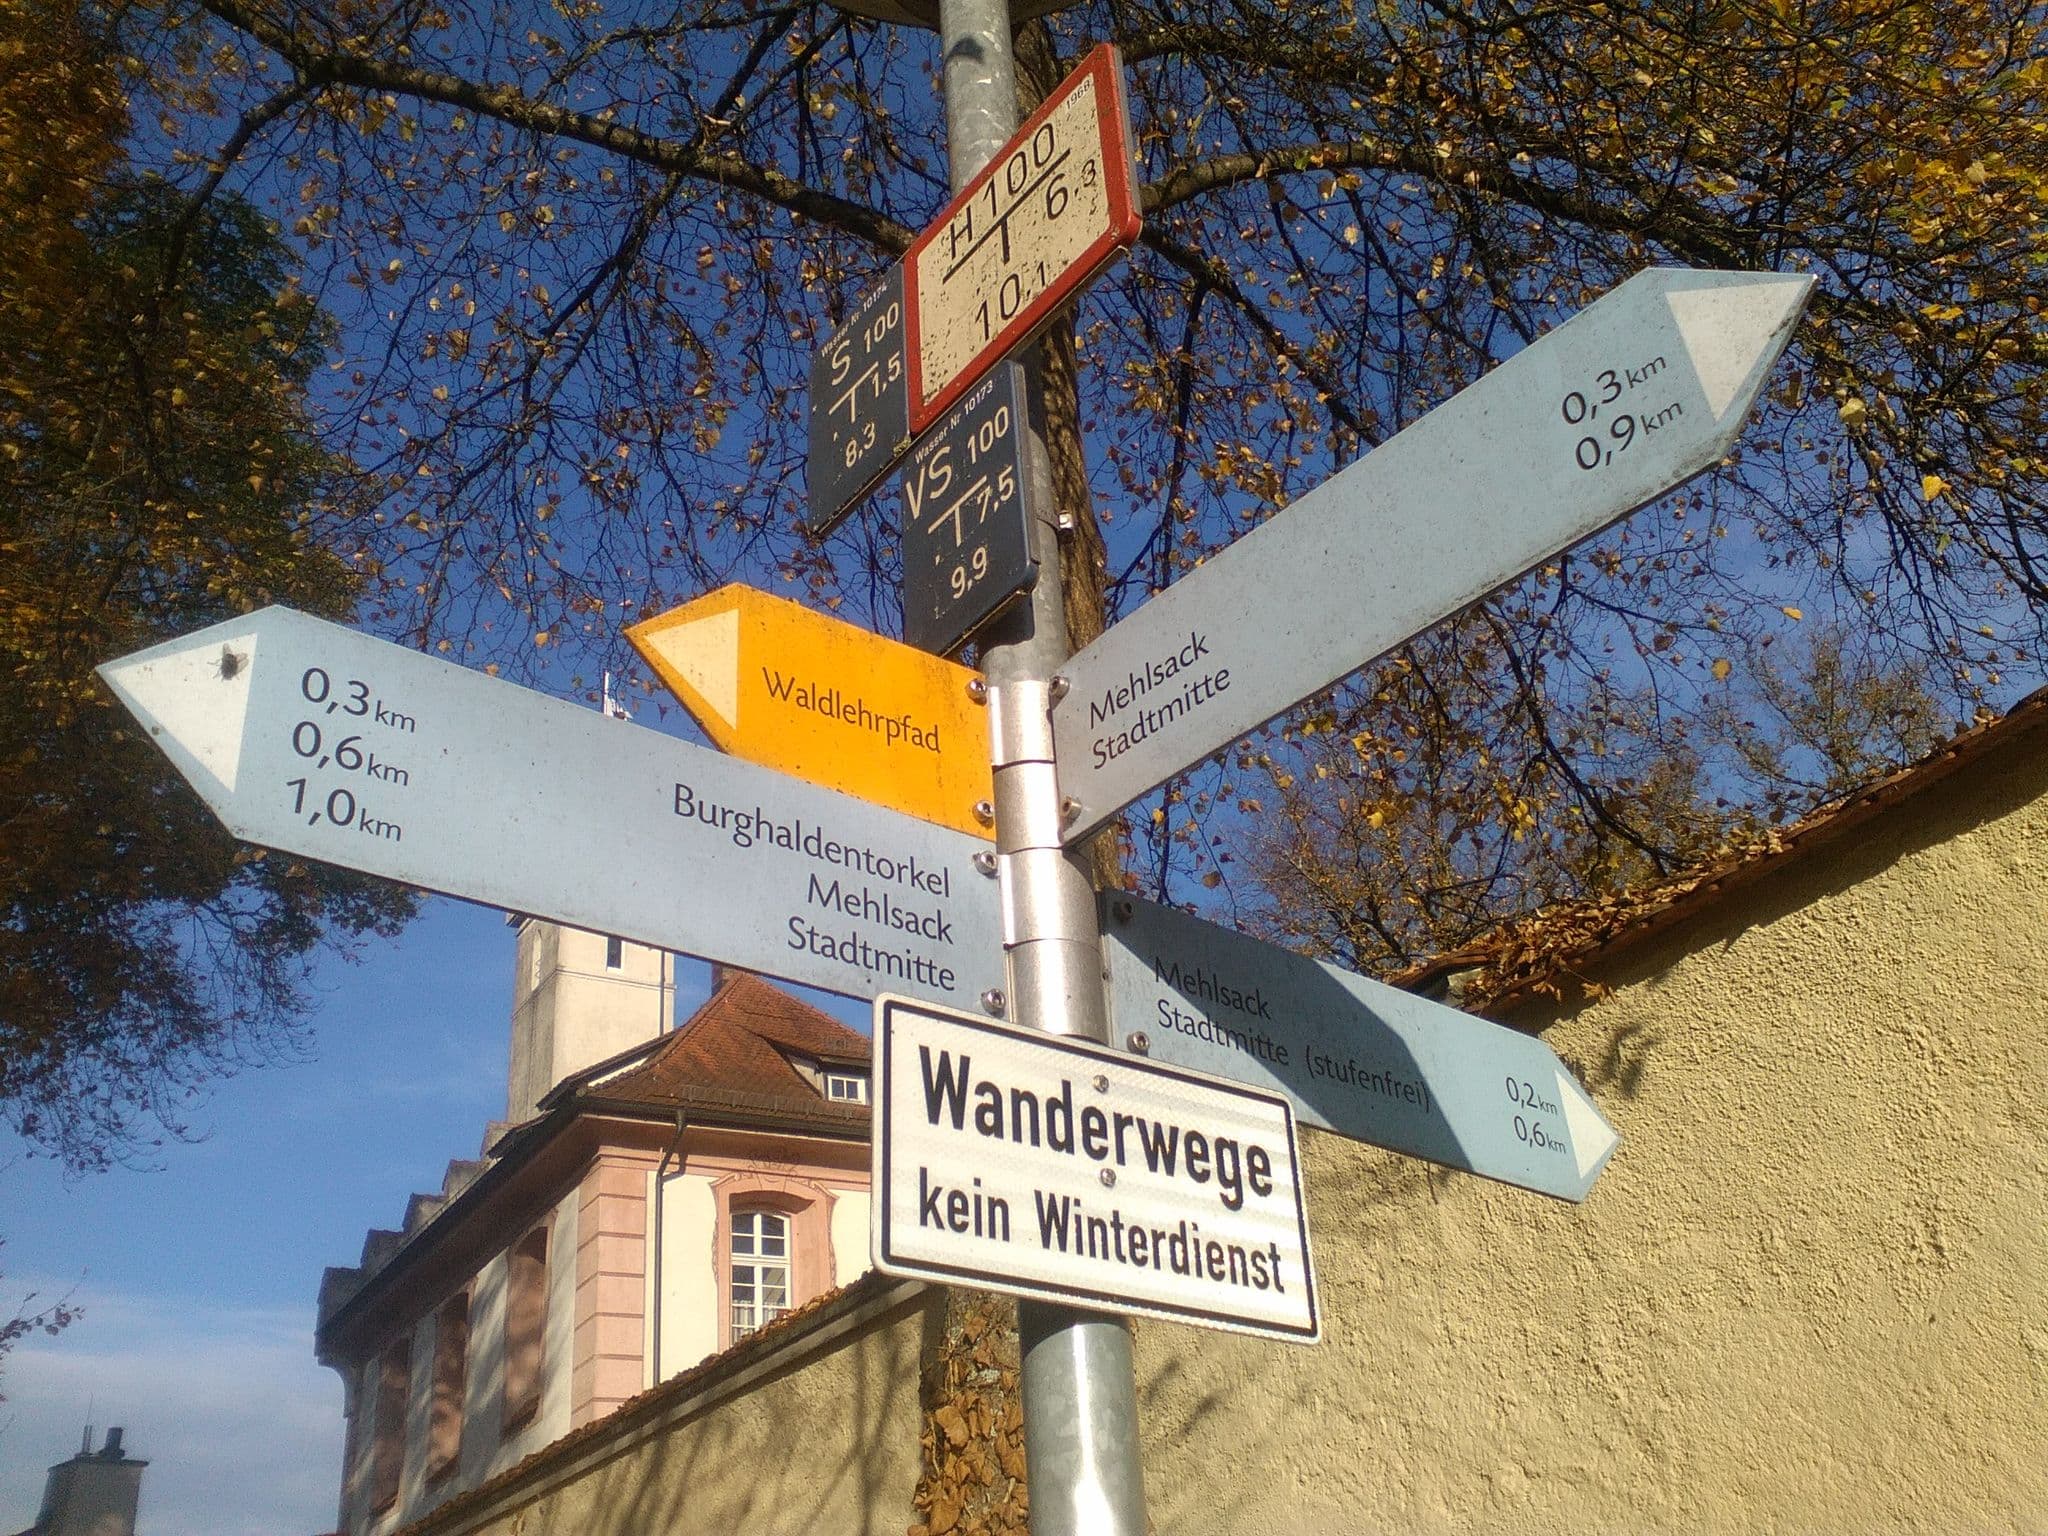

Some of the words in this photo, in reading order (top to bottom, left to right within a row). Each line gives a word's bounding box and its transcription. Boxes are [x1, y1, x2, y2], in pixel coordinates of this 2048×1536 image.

[821, 322, 850, 358] Wasser
[975, 260, 1046, 341] 10,1
[831, 339, 851, 386] S
[863, 301, 899, 353] 100
[845, 421, 876, 468] 8,3
[905, 446, 952, 520] VS
[967, 405, 1009, 464] 100
[914, 426, 948, 464] Wasser
[964, 379, 993, 416] 10173
[976, 464, 1015, 524] 7,5
[951, 546, 988, 599] 9,9
[762, 666, 941, 754] Waldlehrpfad
[1089, 632, 1210, 730] Mehlsack
[1092, 668, 1231, 770] Stadtmitte
[673, 782, 951, 898] Burghaldentorkel
[807, 872, 955, 945] Mehlsack
[787, 916, 957, 991] Stadtmitte
[1155, 957, 1271, 1021] Mehlsack
[1158, 999, 1290, 1067] Stadtmitte
[1305, 1045, 1431, 1113] (stufenfrei)
[918, 1044, 1274, 1211] Wanderwege
[918, 1166, 1011, 1243] kein
[1034, 1189, 1285, 1294] Winterdienst
